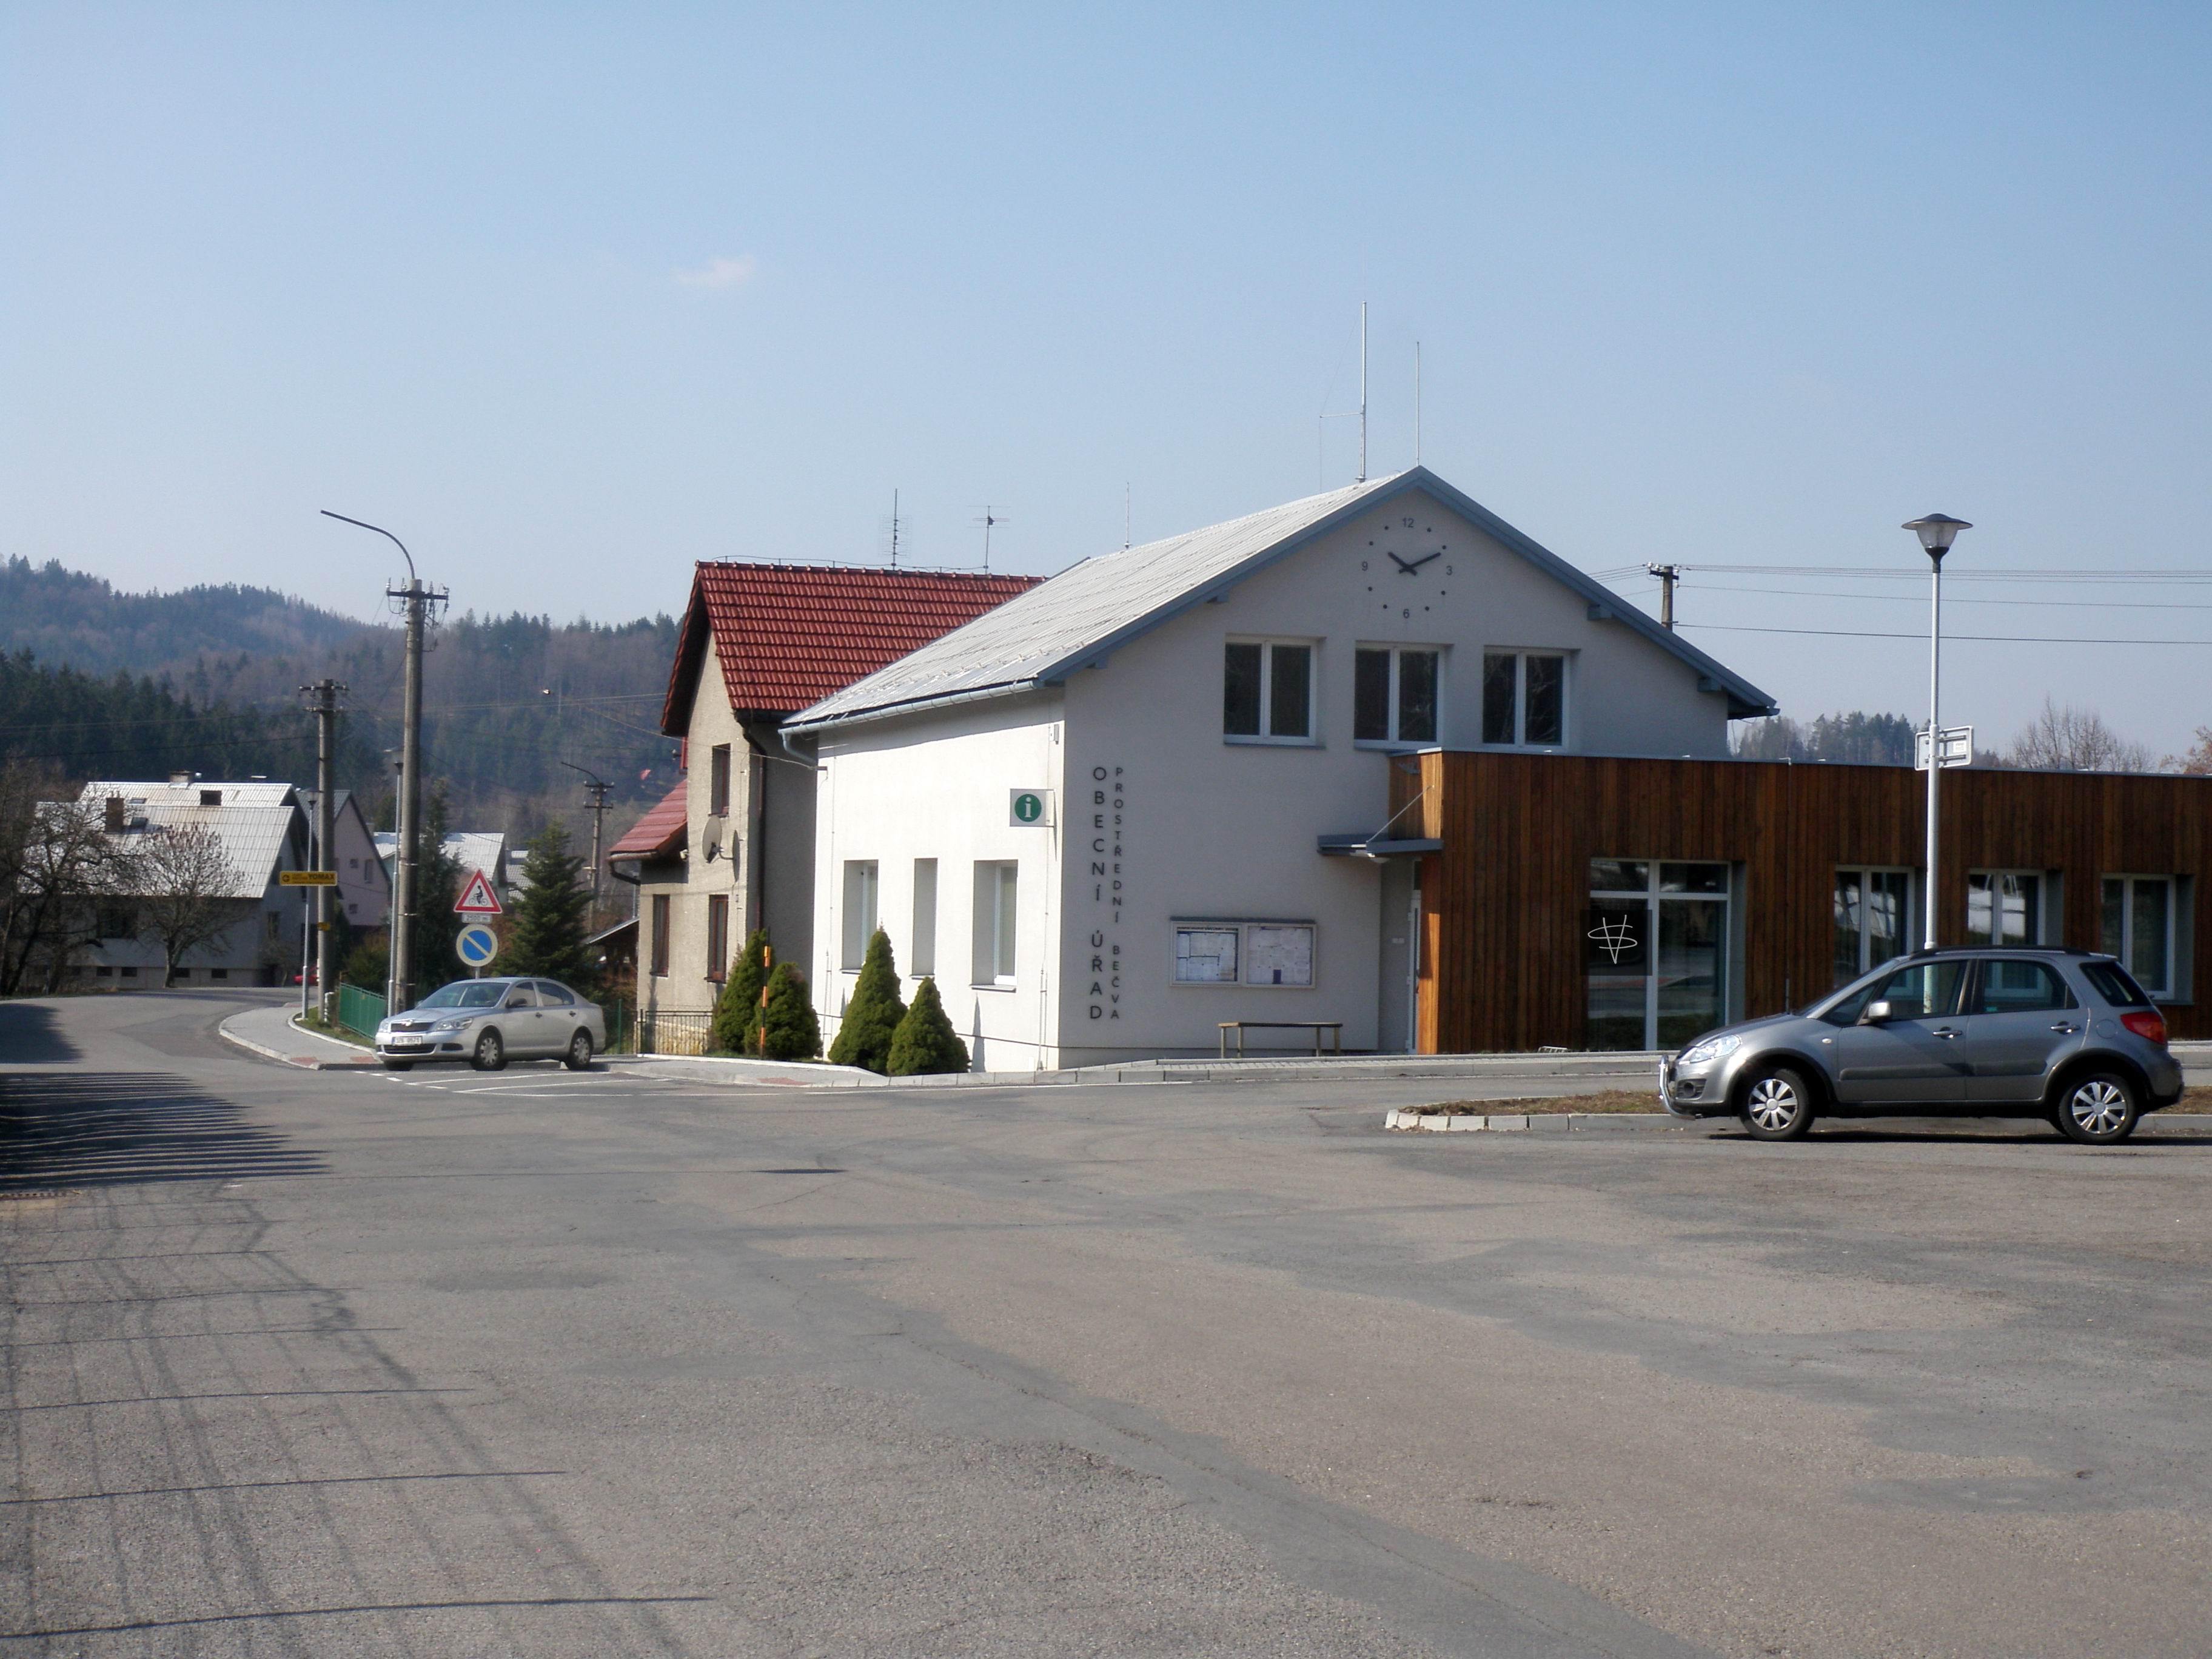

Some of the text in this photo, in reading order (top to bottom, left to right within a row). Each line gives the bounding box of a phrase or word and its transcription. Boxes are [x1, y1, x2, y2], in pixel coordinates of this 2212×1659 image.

[1403, 518, 1415, 528] 12
[1361, 561, 1369, 571] 9
[1446, 565, 1453, 575] 3
[1403, 608, 1410, 619] 6
[1089, 766, 1107, 1020] OBECNÍ ÚŘAD
[1110, 767, 1124, 1020] PROSTŘEDNÍ BEČVA
